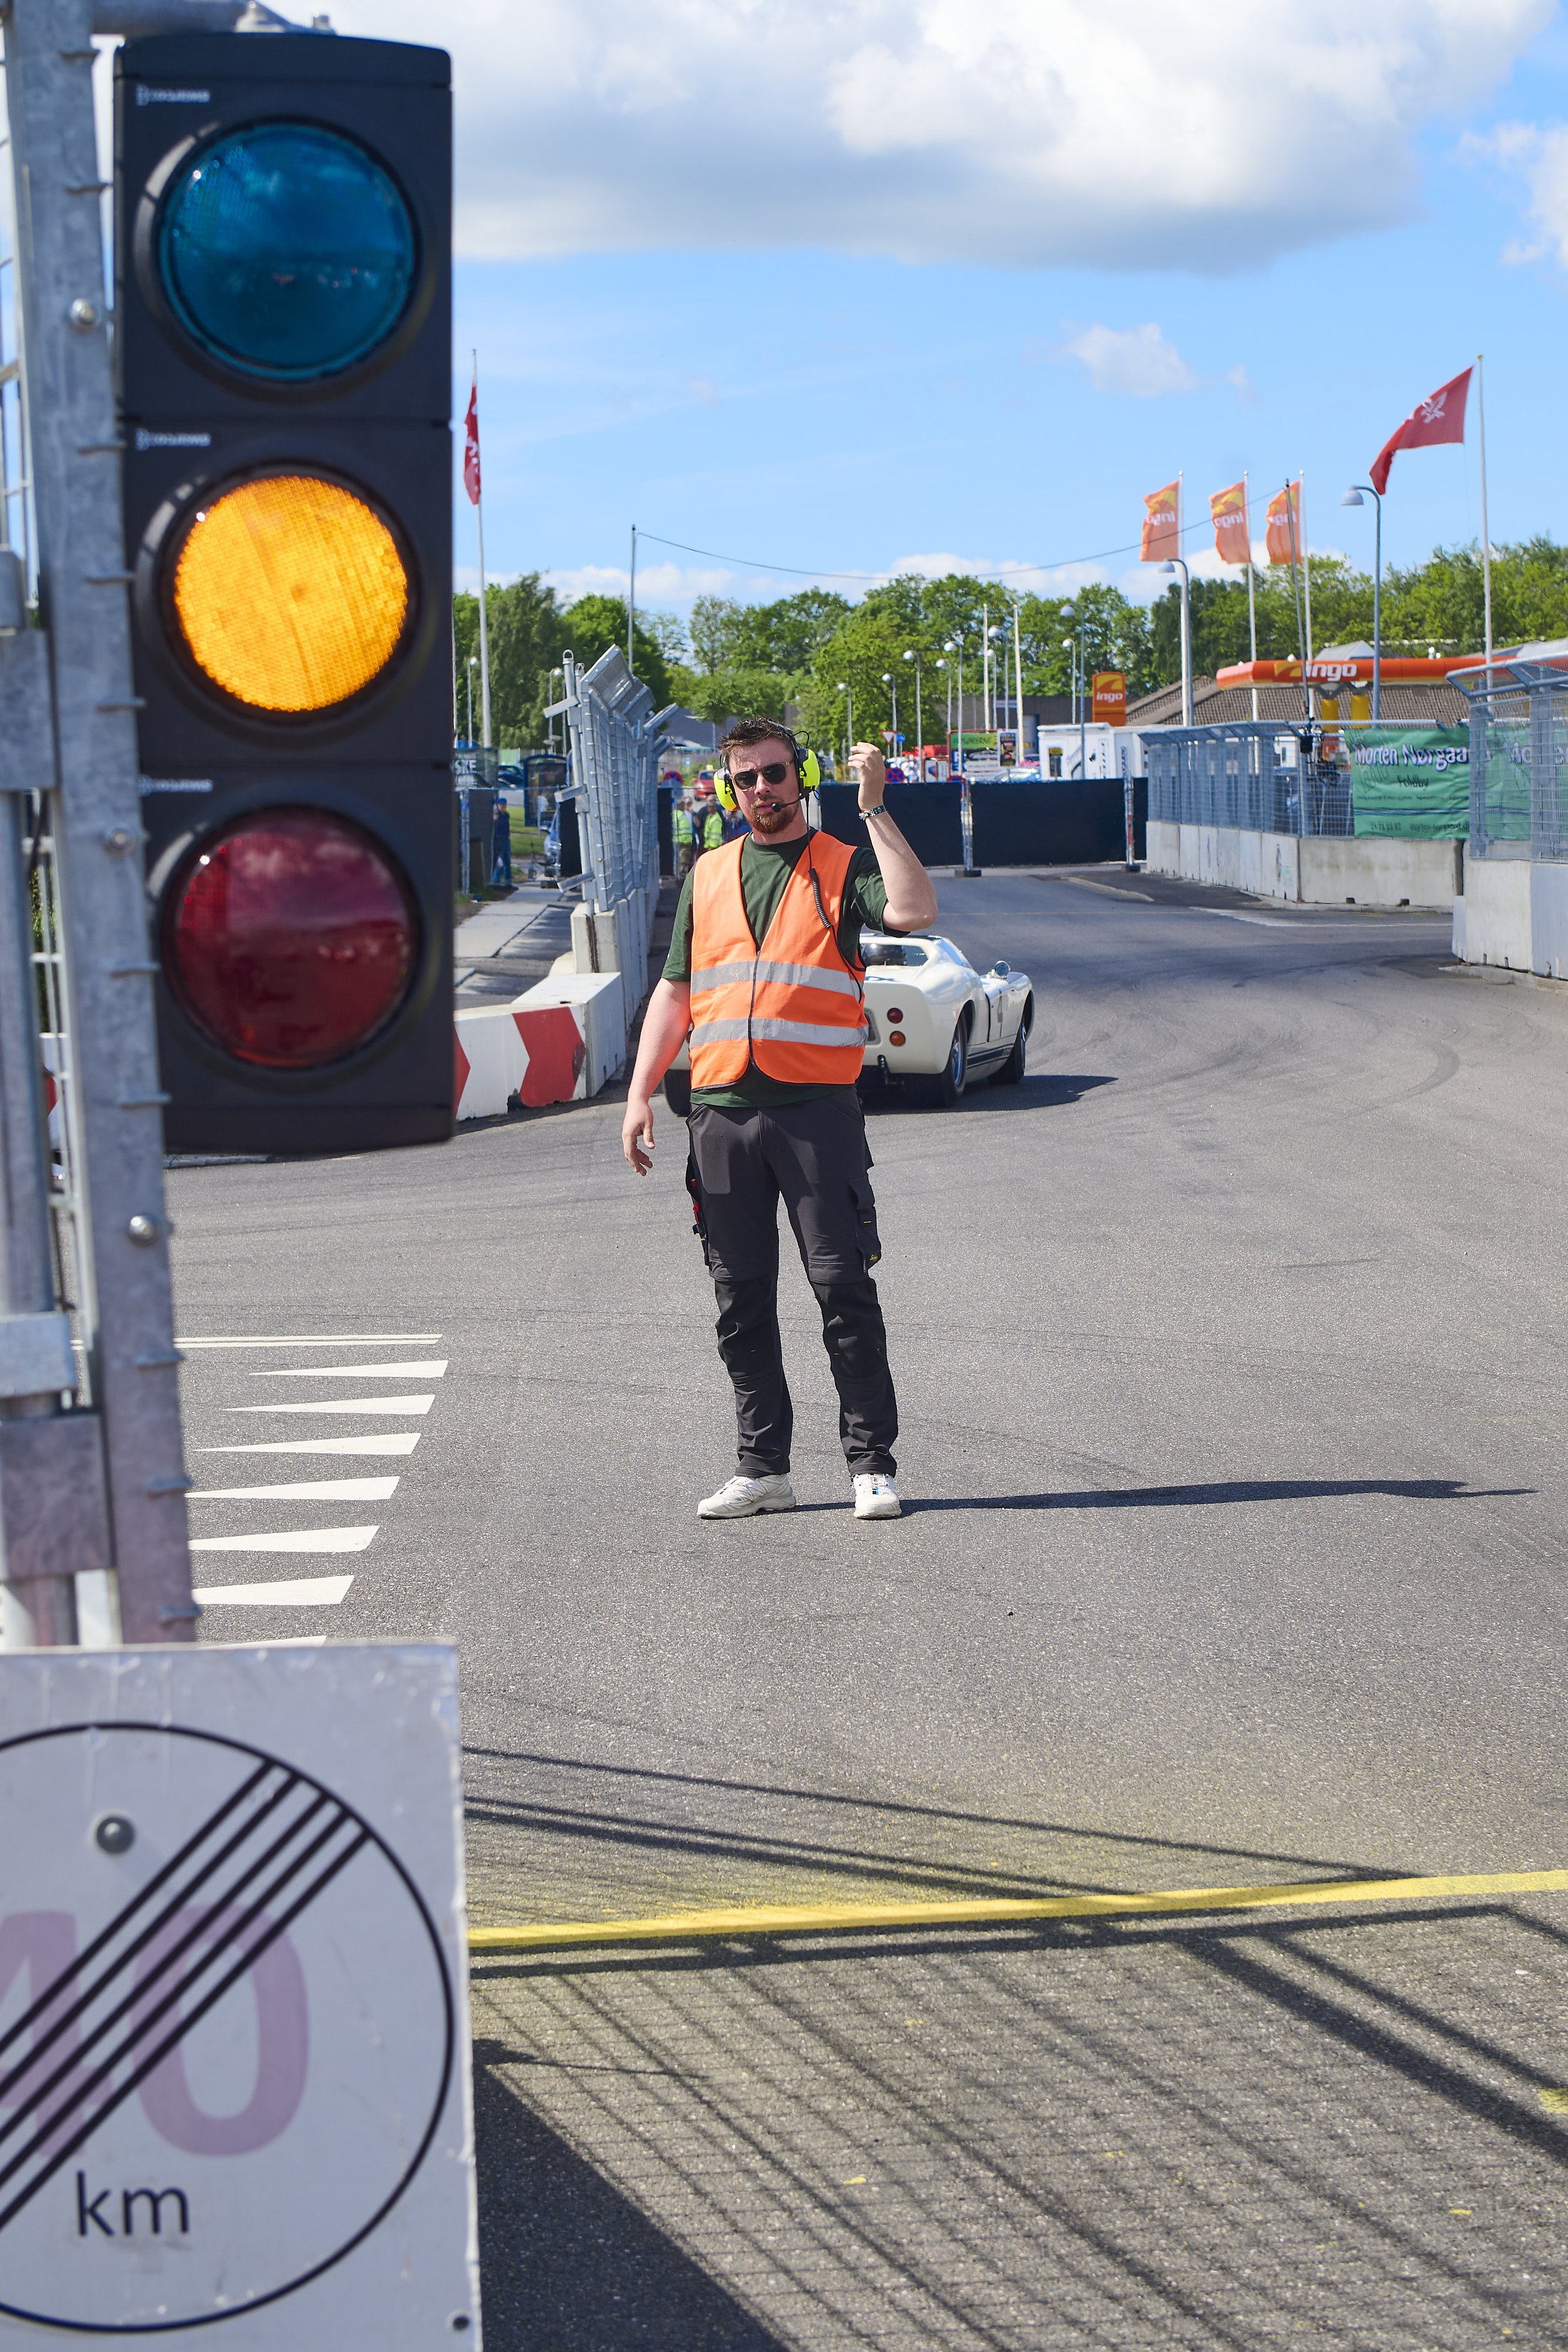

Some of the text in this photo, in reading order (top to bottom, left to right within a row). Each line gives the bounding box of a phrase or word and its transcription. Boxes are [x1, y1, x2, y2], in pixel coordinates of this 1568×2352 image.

[1305, 662, 1357, 682] ingo
[1096, 691, 1123, 703] ingo
[1353, 743, 1491, 771] Morten Nørgaa
[76, 2169, 189, 2237] km
